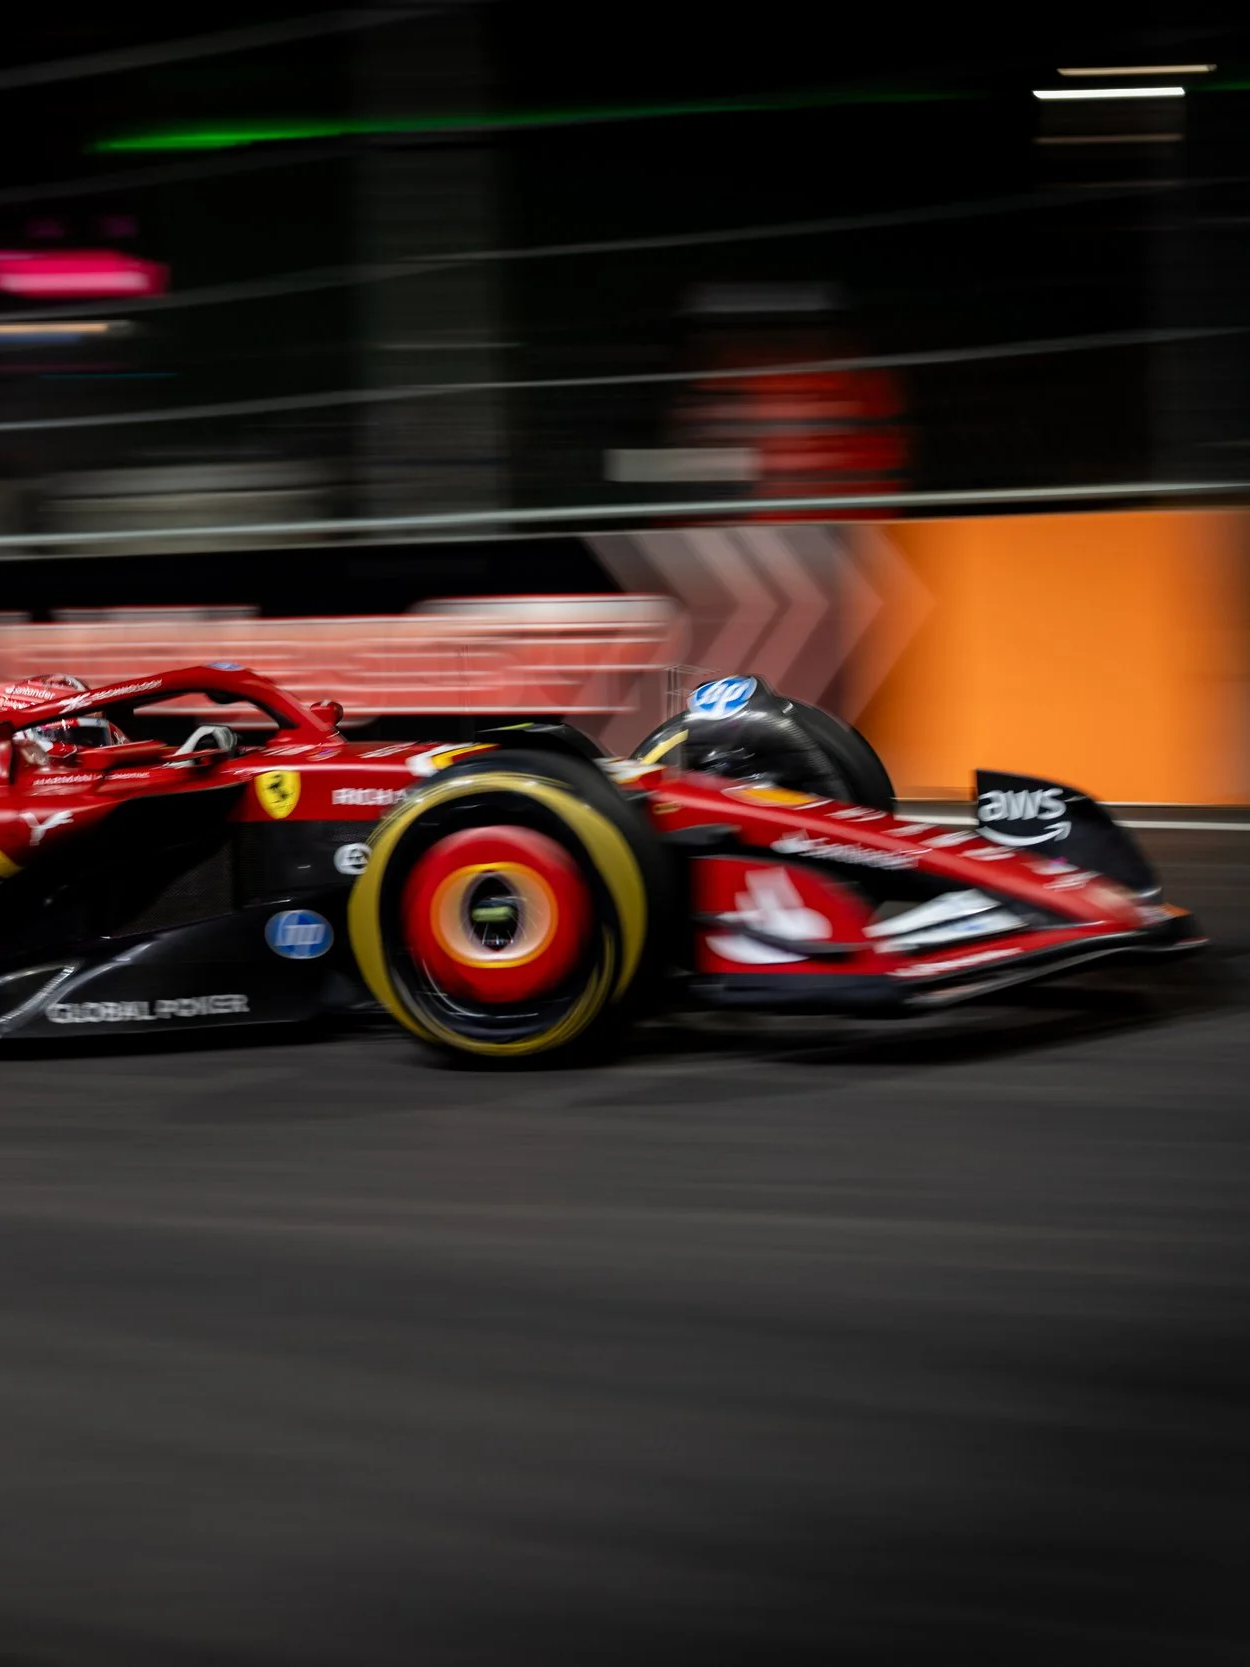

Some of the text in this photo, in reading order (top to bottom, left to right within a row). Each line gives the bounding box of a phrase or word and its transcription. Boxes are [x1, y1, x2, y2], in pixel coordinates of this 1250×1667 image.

[692, 676, 752, 719] hp
[976, 787, 1067, 822] aws
[46, 1001, 156, 1023] GLOBAL
